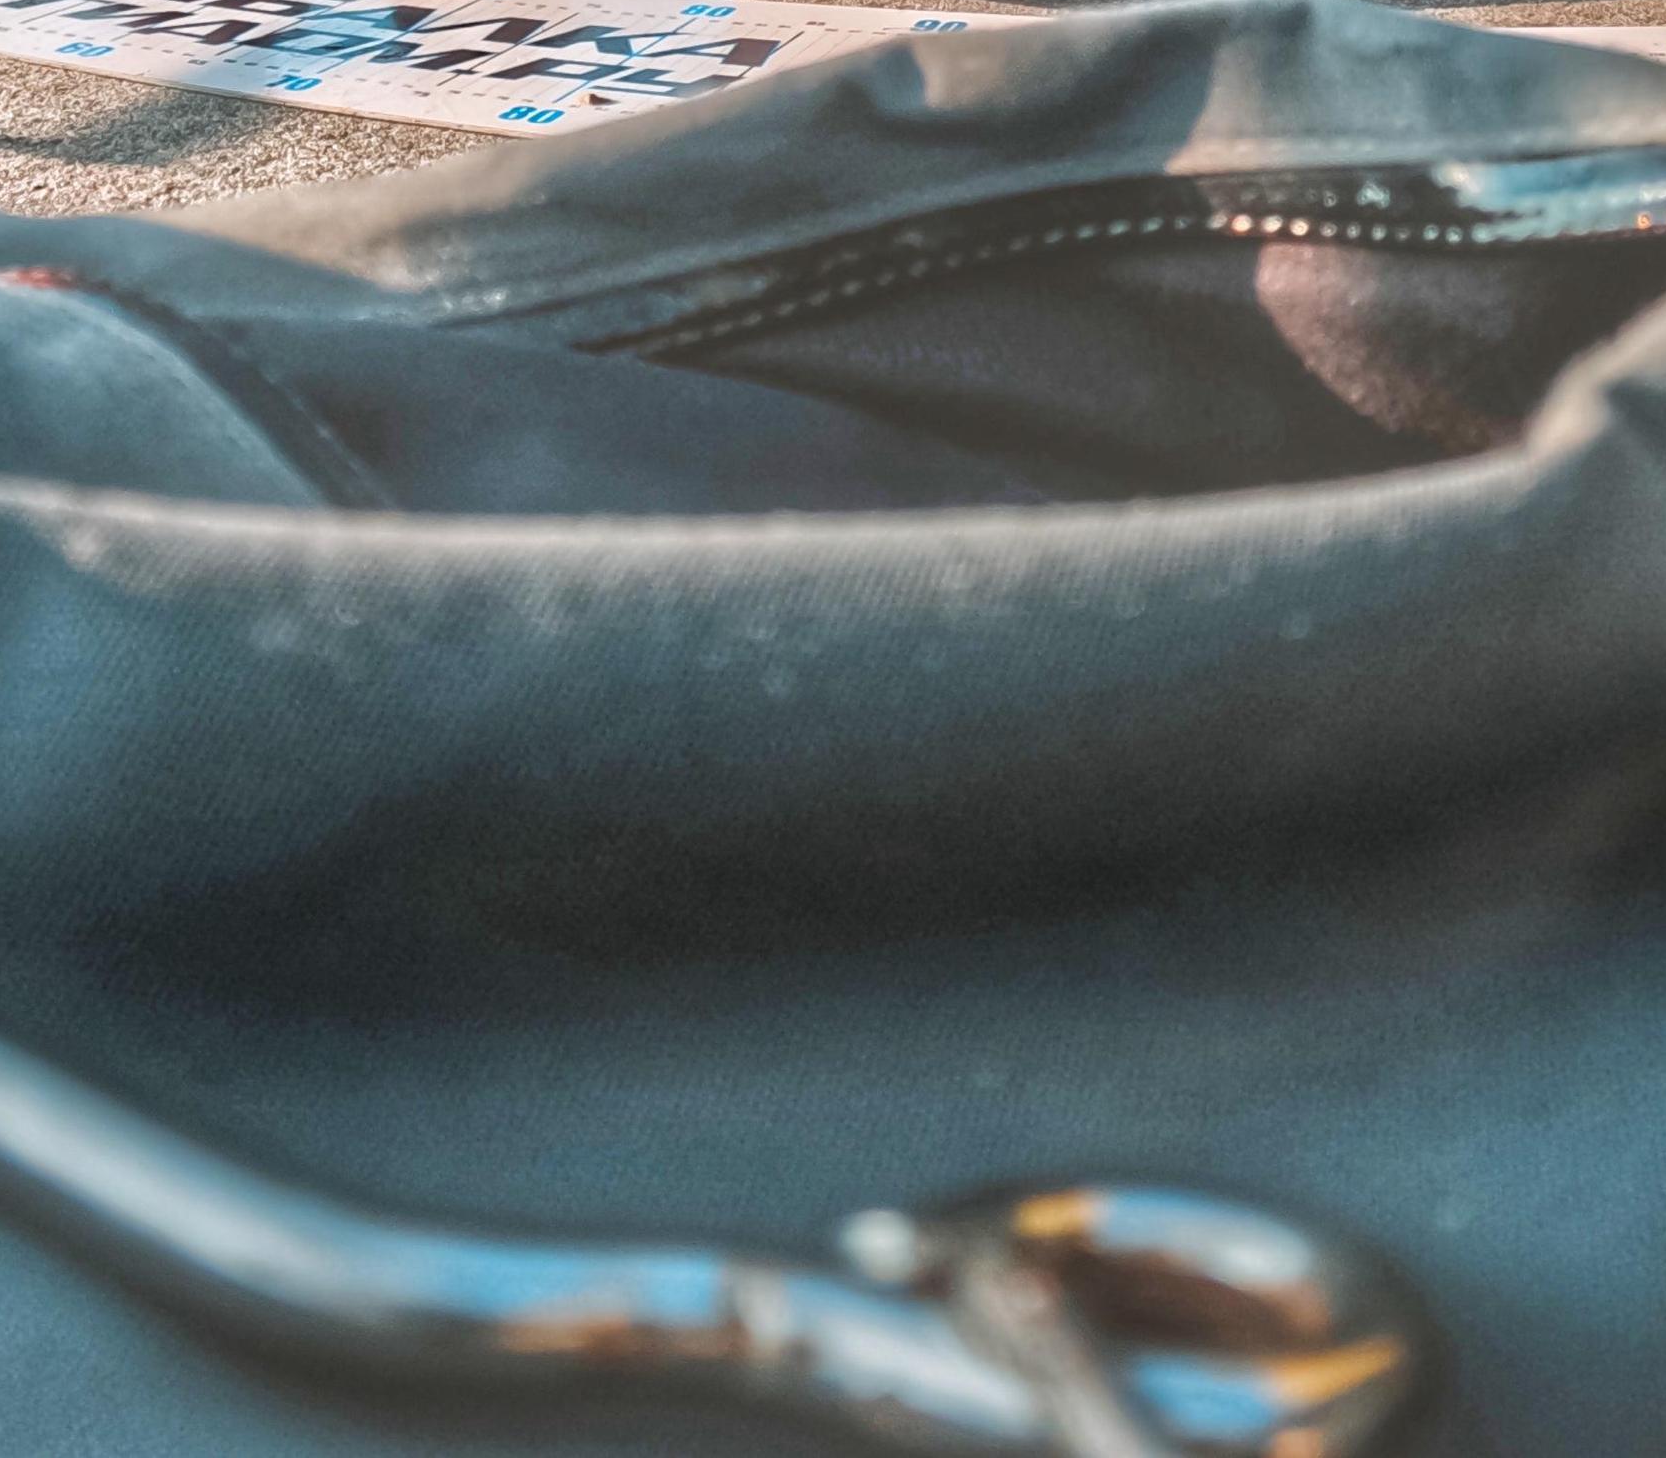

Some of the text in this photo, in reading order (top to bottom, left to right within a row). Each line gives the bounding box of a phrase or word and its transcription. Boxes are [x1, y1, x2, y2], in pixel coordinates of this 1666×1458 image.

[680, 4, 736, 18] 80
[911, 19, 968, 32] 90
[54, 42, 115, 57] 60
[266, 74, 323, 91] 70
[498, 106, 566, 124] 80
